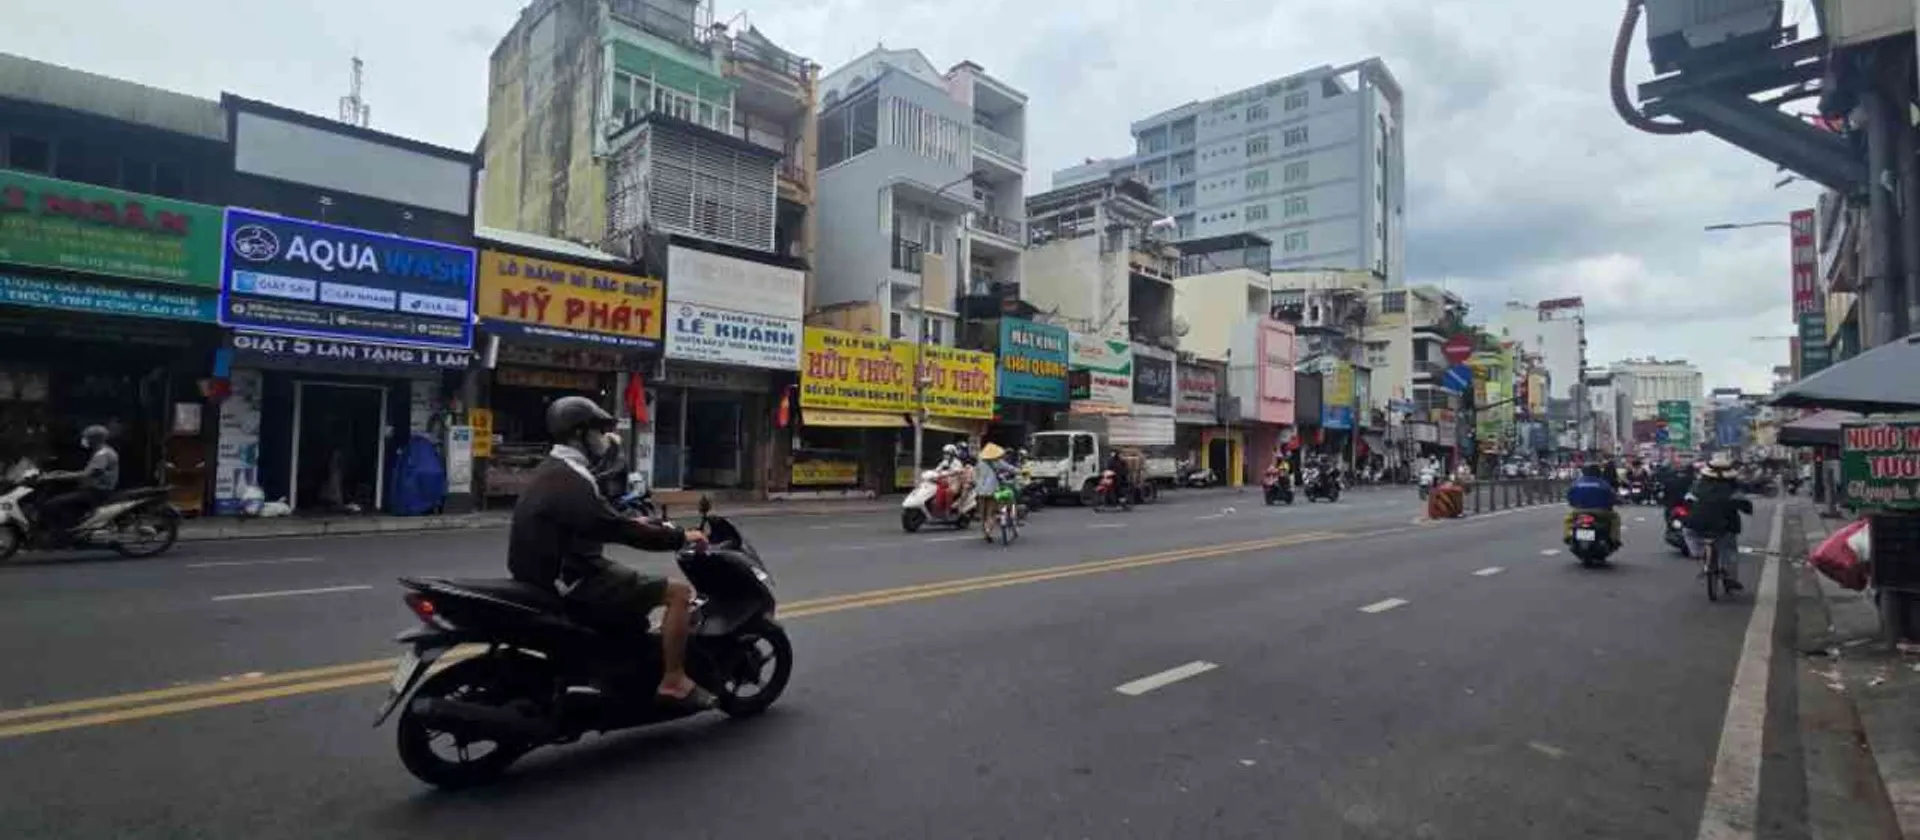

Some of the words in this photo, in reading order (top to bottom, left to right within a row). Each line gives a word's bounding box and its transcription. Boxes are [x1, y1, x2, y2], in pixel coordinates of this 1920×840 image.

[285, 235, 380, 273] AQUA
[384, 251, 470, 284] WASH
[501, 286, 552, 322] MỸ
[565, 300, 653, 334] PHÁT
